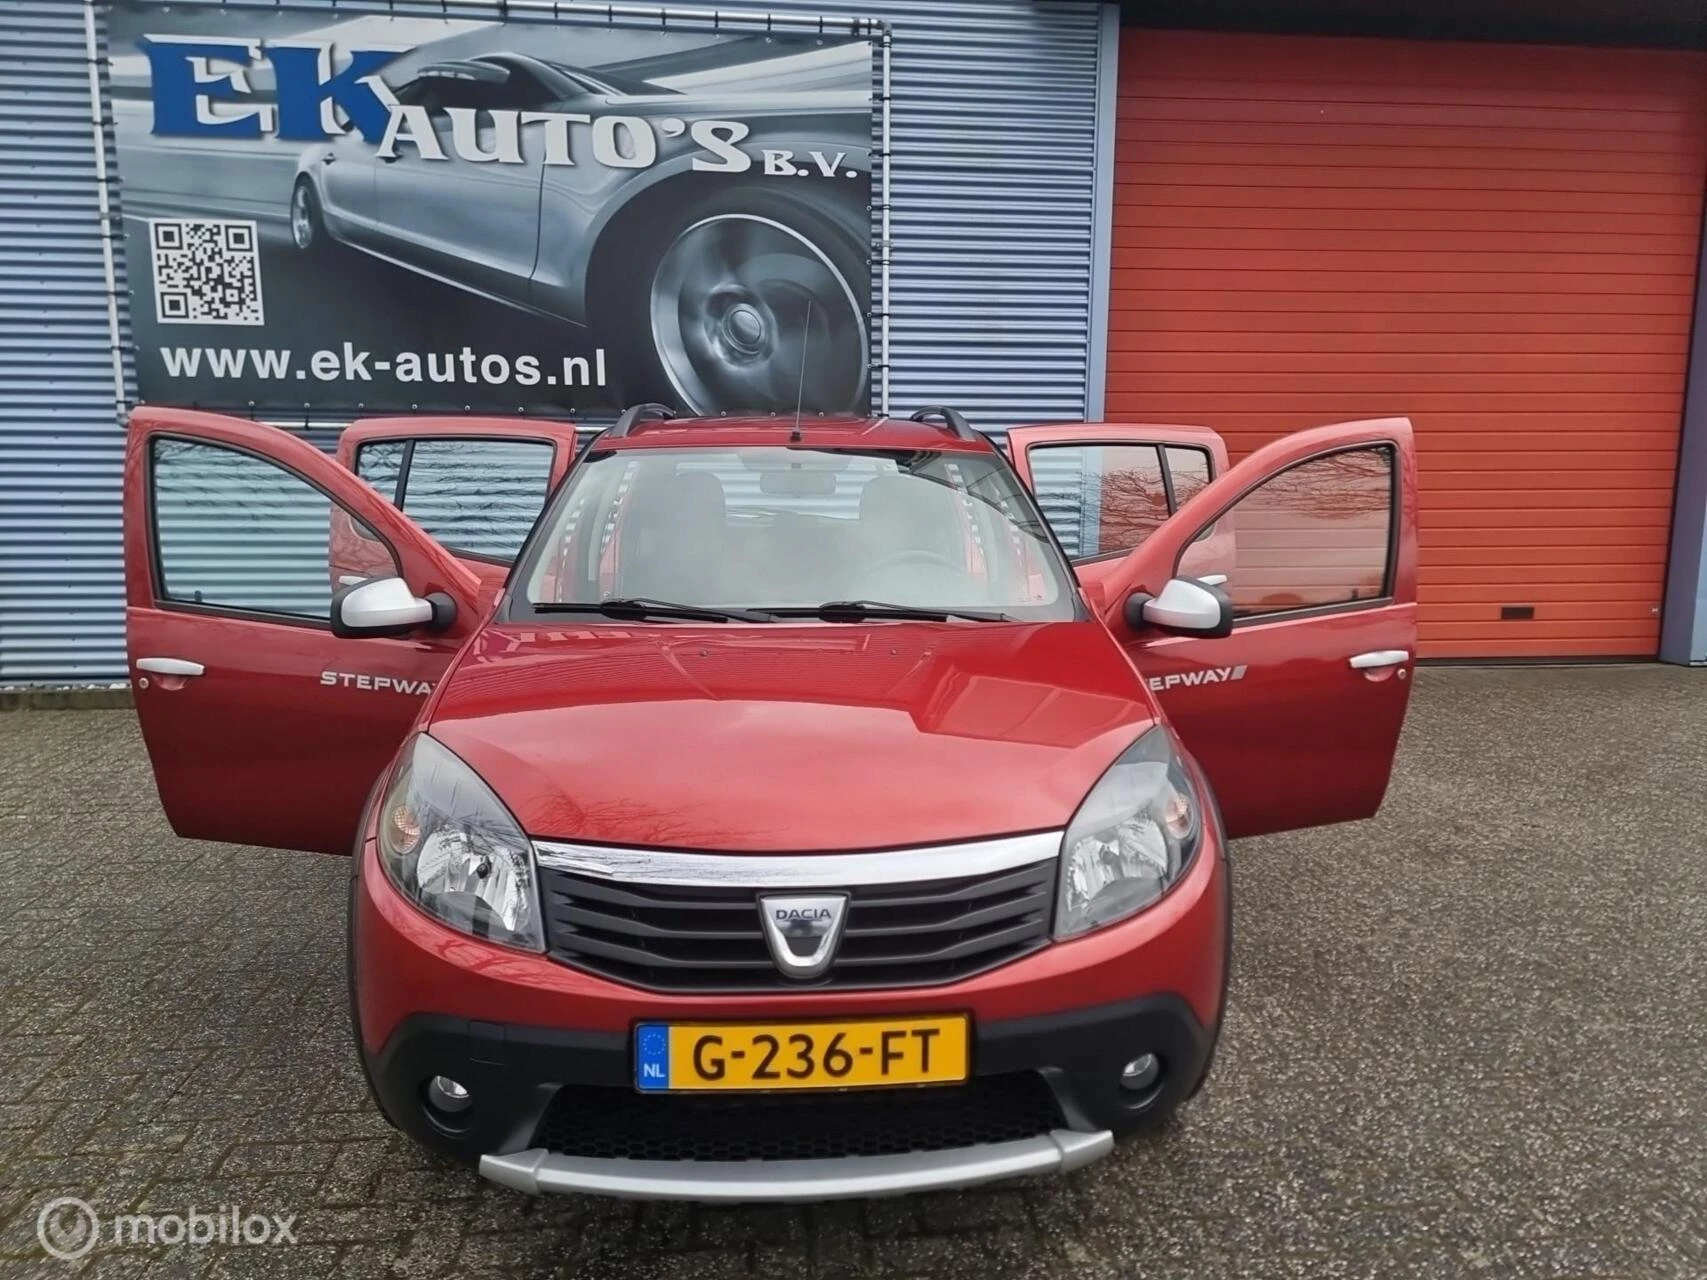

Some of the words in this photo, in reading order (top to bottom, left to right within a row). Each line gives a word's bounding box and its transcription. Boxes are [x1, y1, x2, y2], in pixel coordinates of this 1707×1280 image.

[144, 33, 418, 145] EK
[375, 104, 752, 174] AUTO'S
[762, 149, 859, 179] B.V.
[160, 342, 607, 386] www.ek-autos.nl
[320, 671, 436, 696] STEPWA
[775, 908, 832, 921] DACIA
[643, 1063, 665, 1079] NL
[693, 1028, 940, 1081] G-236-FT
